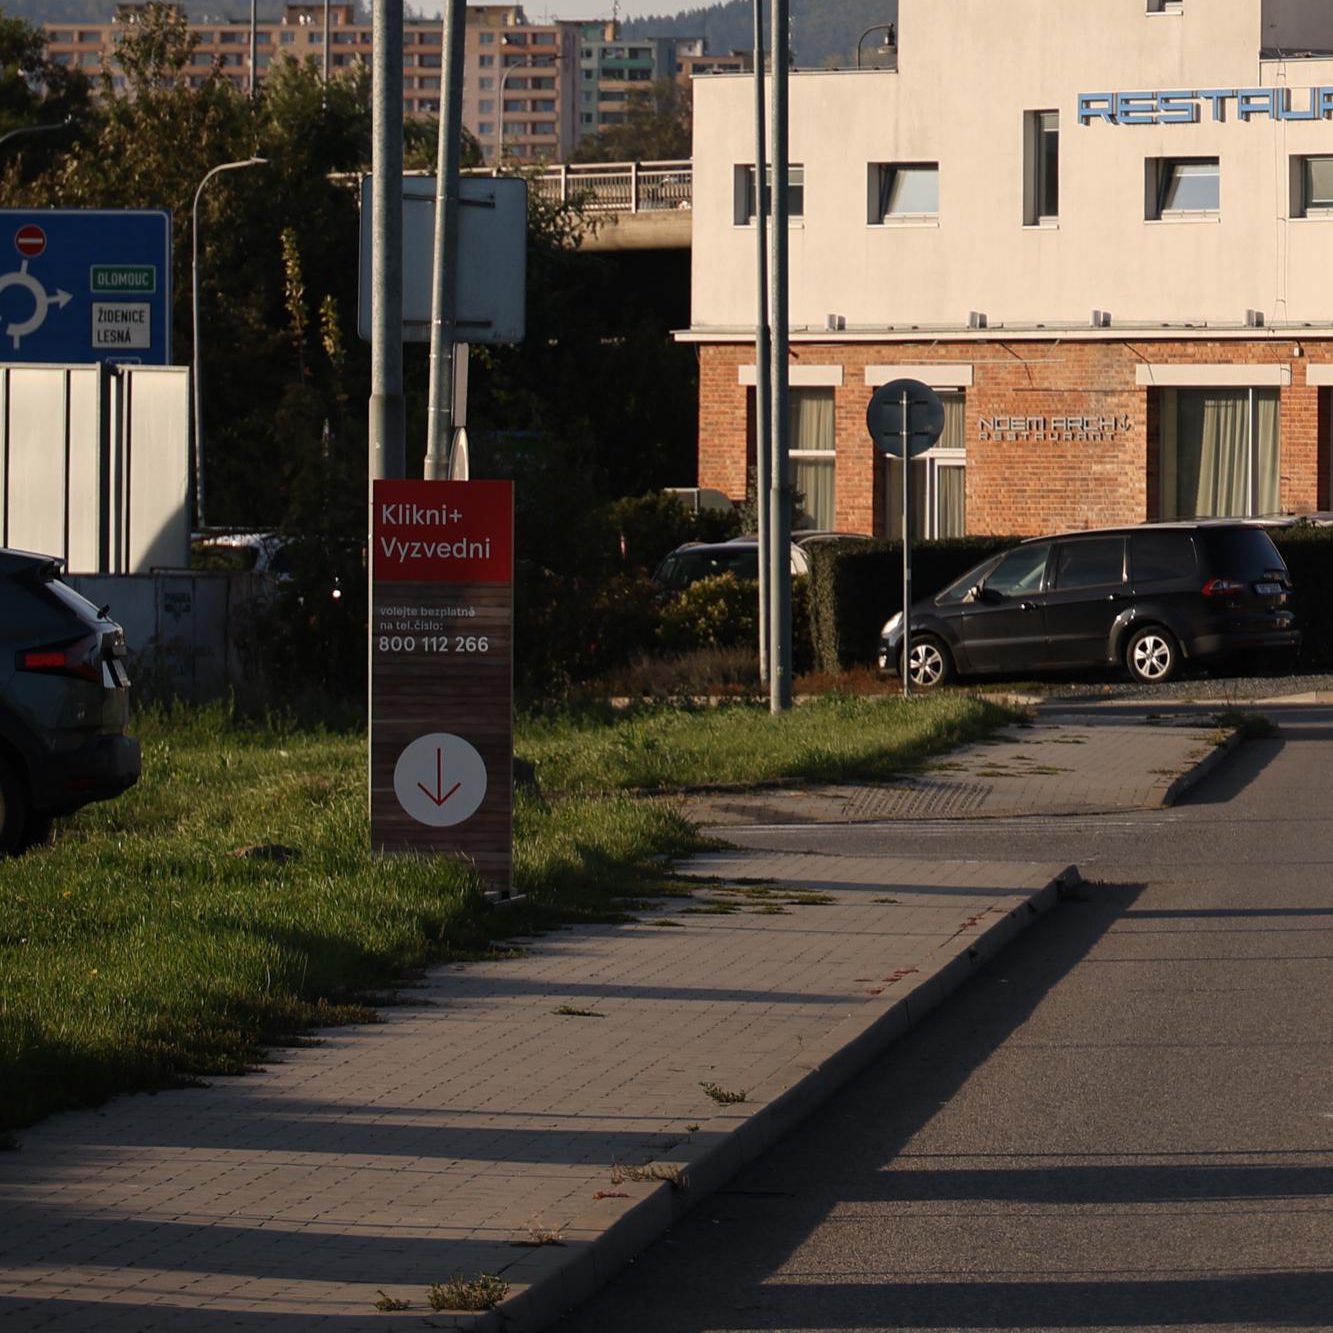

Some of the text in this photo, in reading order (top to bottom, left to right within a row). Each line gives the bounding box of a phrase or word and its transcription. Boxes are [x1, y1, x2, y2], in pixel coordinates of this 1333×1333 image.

[97, 272, 149, 286] OLOMOUC
[97, 307, 145, 324] ŽIDENICE
[97, 328, 131, 343] LESNÁ
[979, 416, 1117, 431] NOEM ARCH
[979, 432, 1117, 442] RESTAURANT
[382, 504, 463, 525] Klikni+
[380, 537, 491, 563] Vyzvedni
[380, 606, 475, 619] volejte bezplatně
[380, 621, 443, 631] na tel.číslo:
[379, 636, 489, 652] 800 112 266
